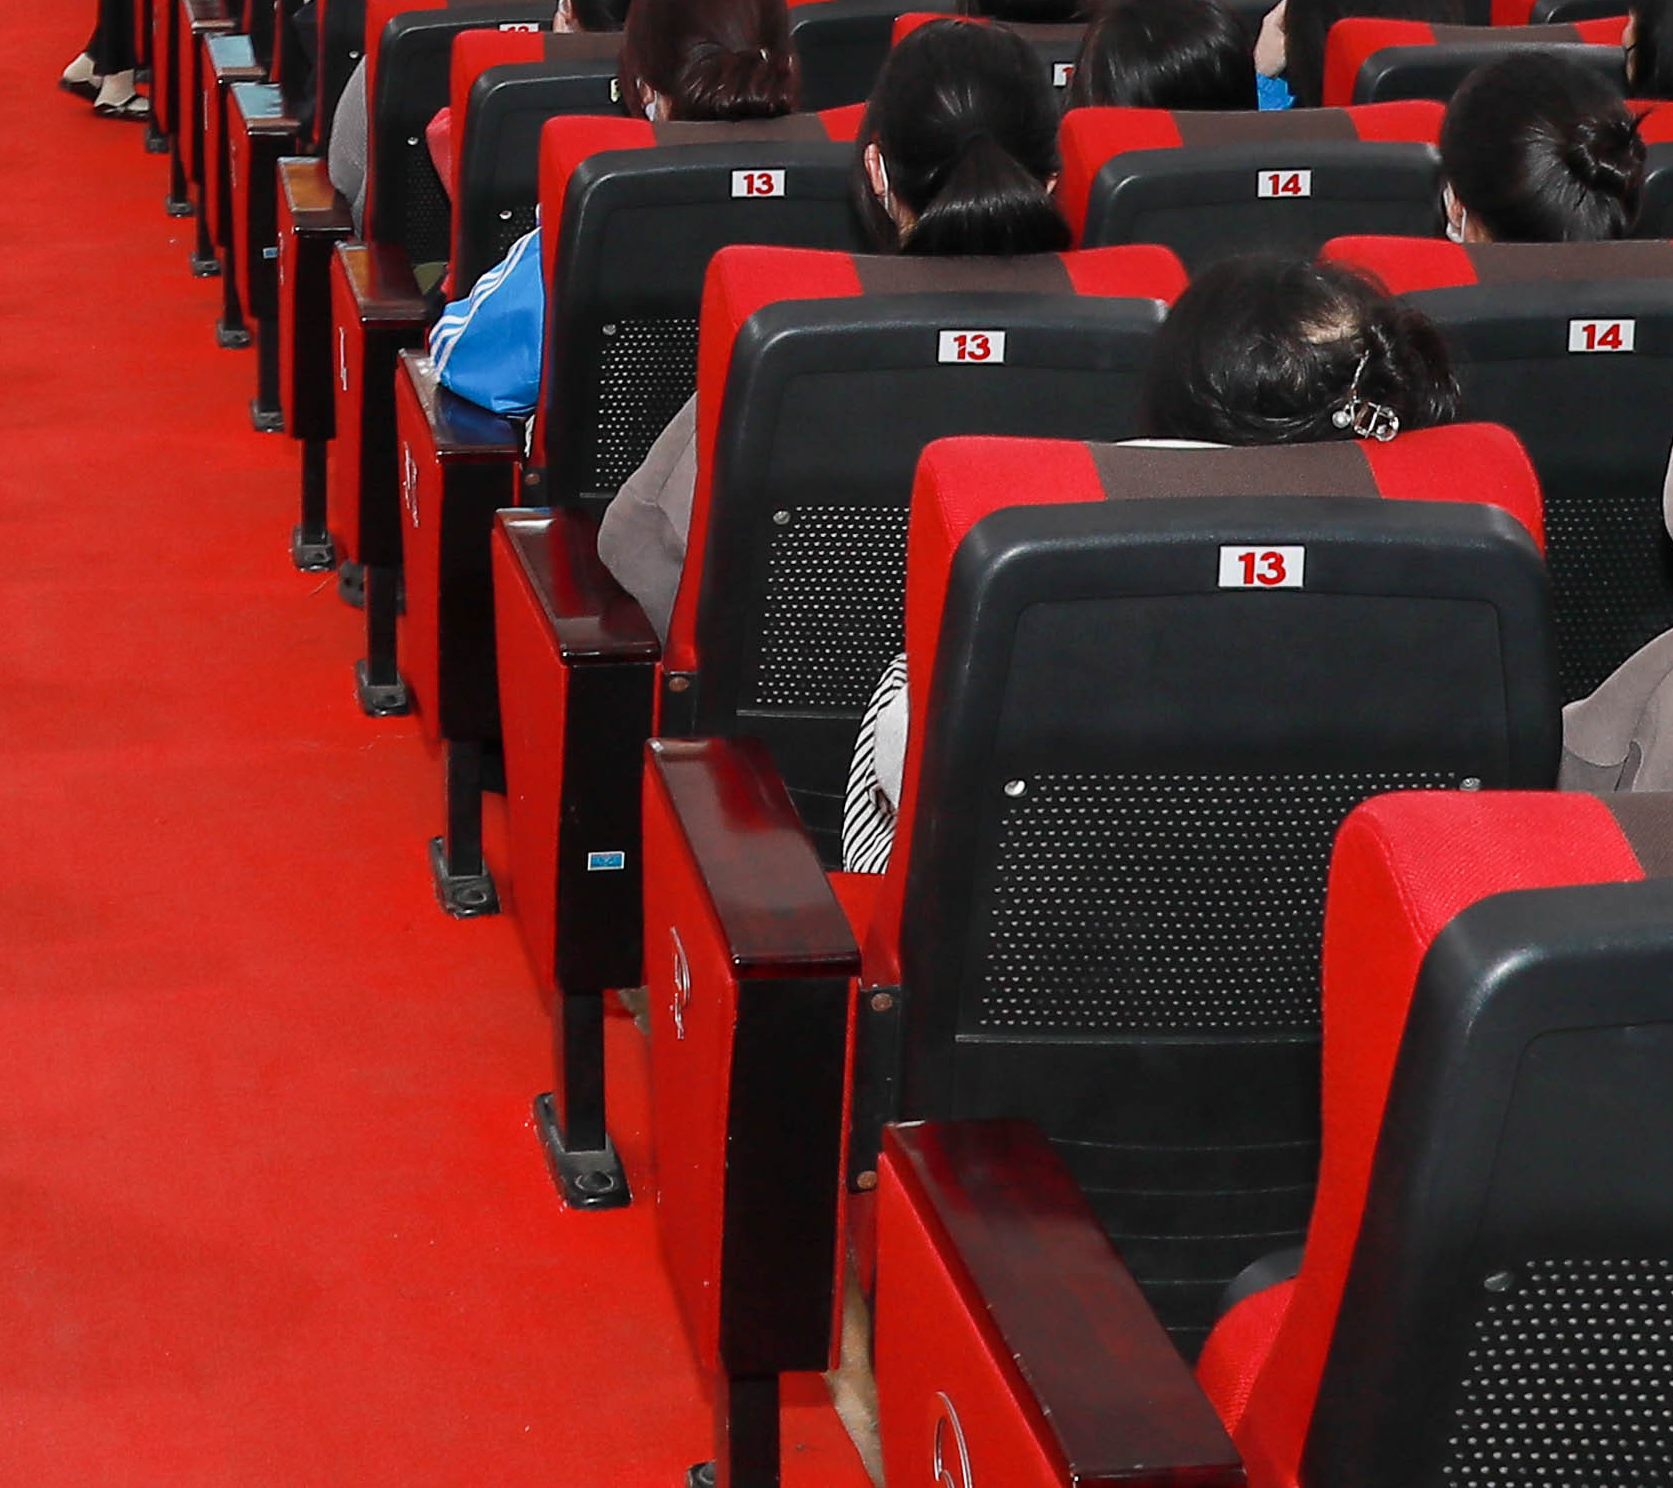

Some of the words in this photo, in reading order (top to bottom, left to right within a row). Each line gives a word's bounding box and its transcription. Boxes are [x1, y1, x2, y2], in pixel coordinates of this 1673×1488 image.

[744, 173, 774, 196] 13
[1269, 174, 1302, 196] 14
[955, 334, 992, 361] 13
[1584, 324, 1622, 350] 14
[1239, 551, 1286, 586] 13
